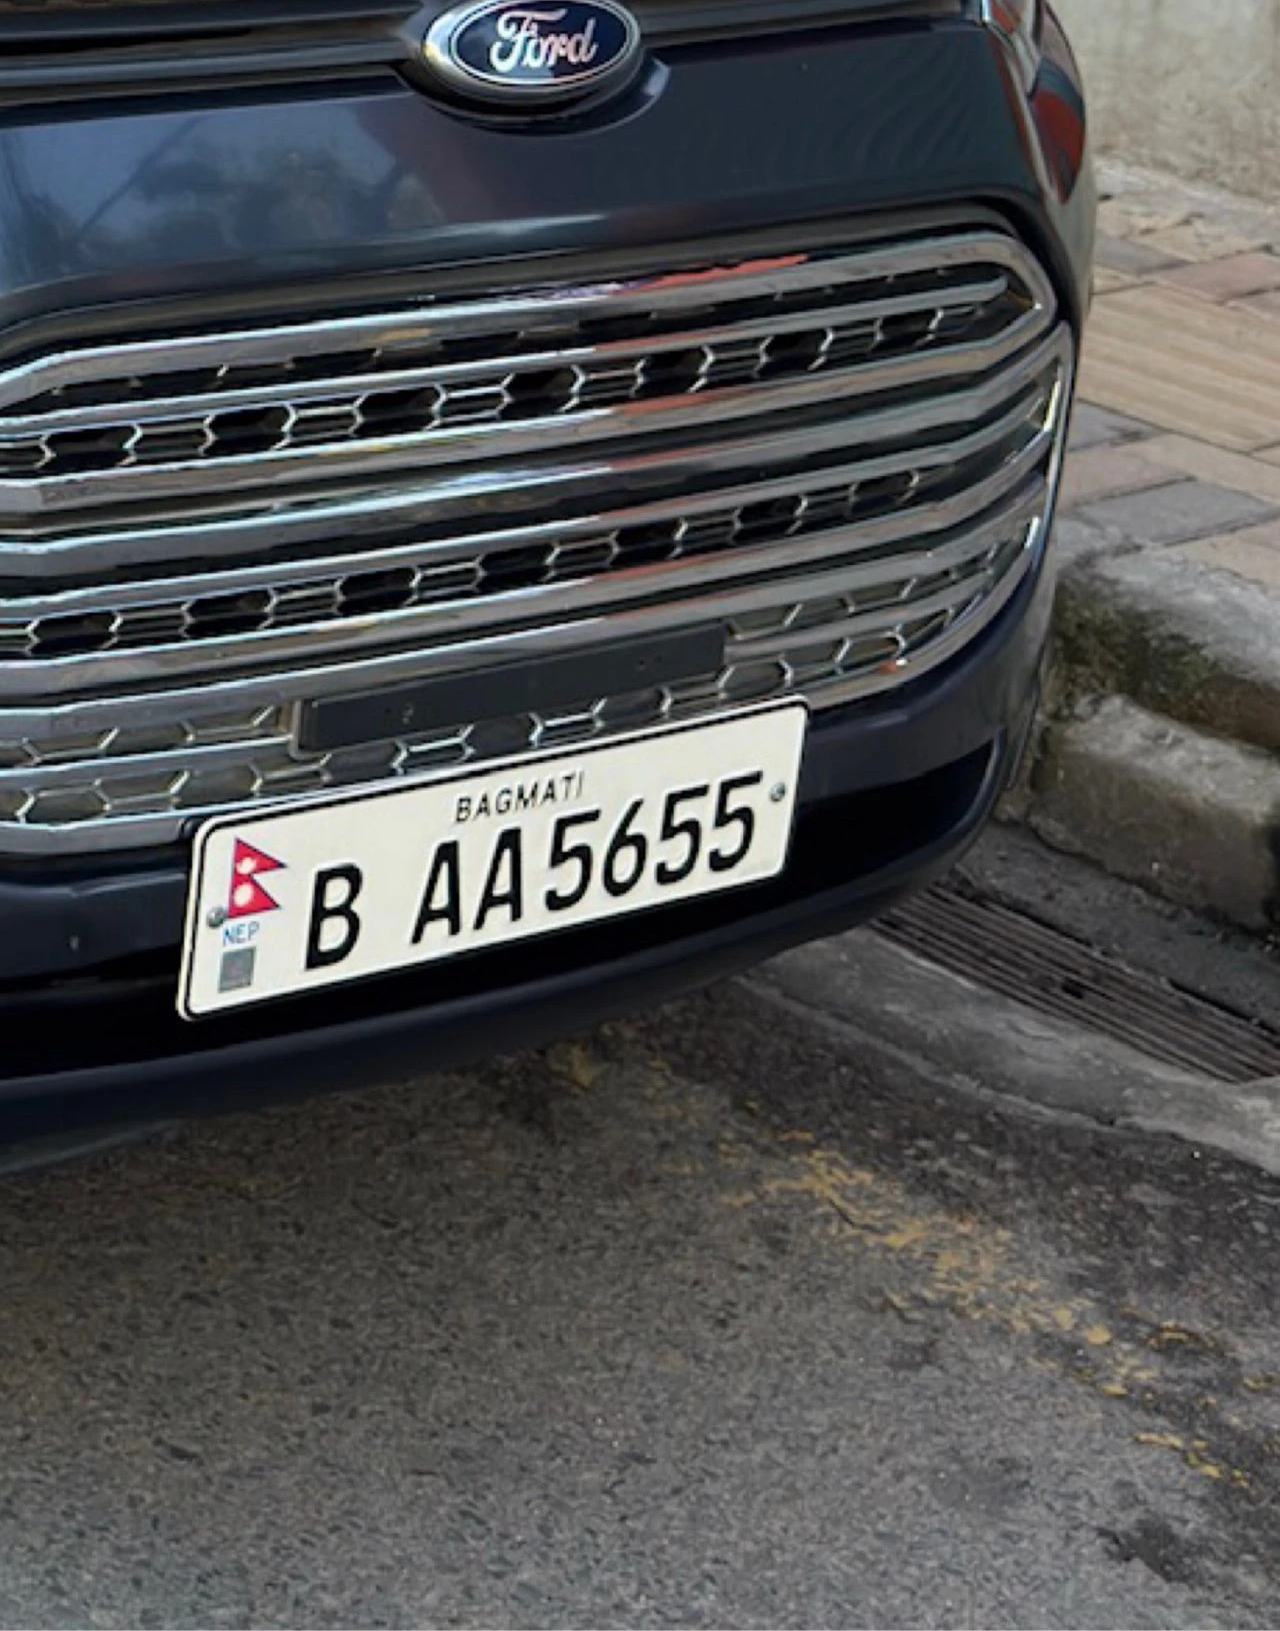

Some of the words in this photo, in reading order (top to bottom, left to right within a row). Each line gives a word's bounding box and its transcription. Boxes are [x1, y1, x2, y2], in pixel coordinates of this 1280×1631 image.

[490, 8, 599, 73] Ford
[454, 770, 584, 823] BAGMATI
[221, 921, 261, 946] NEP
[304, 862, 364, 970] B
